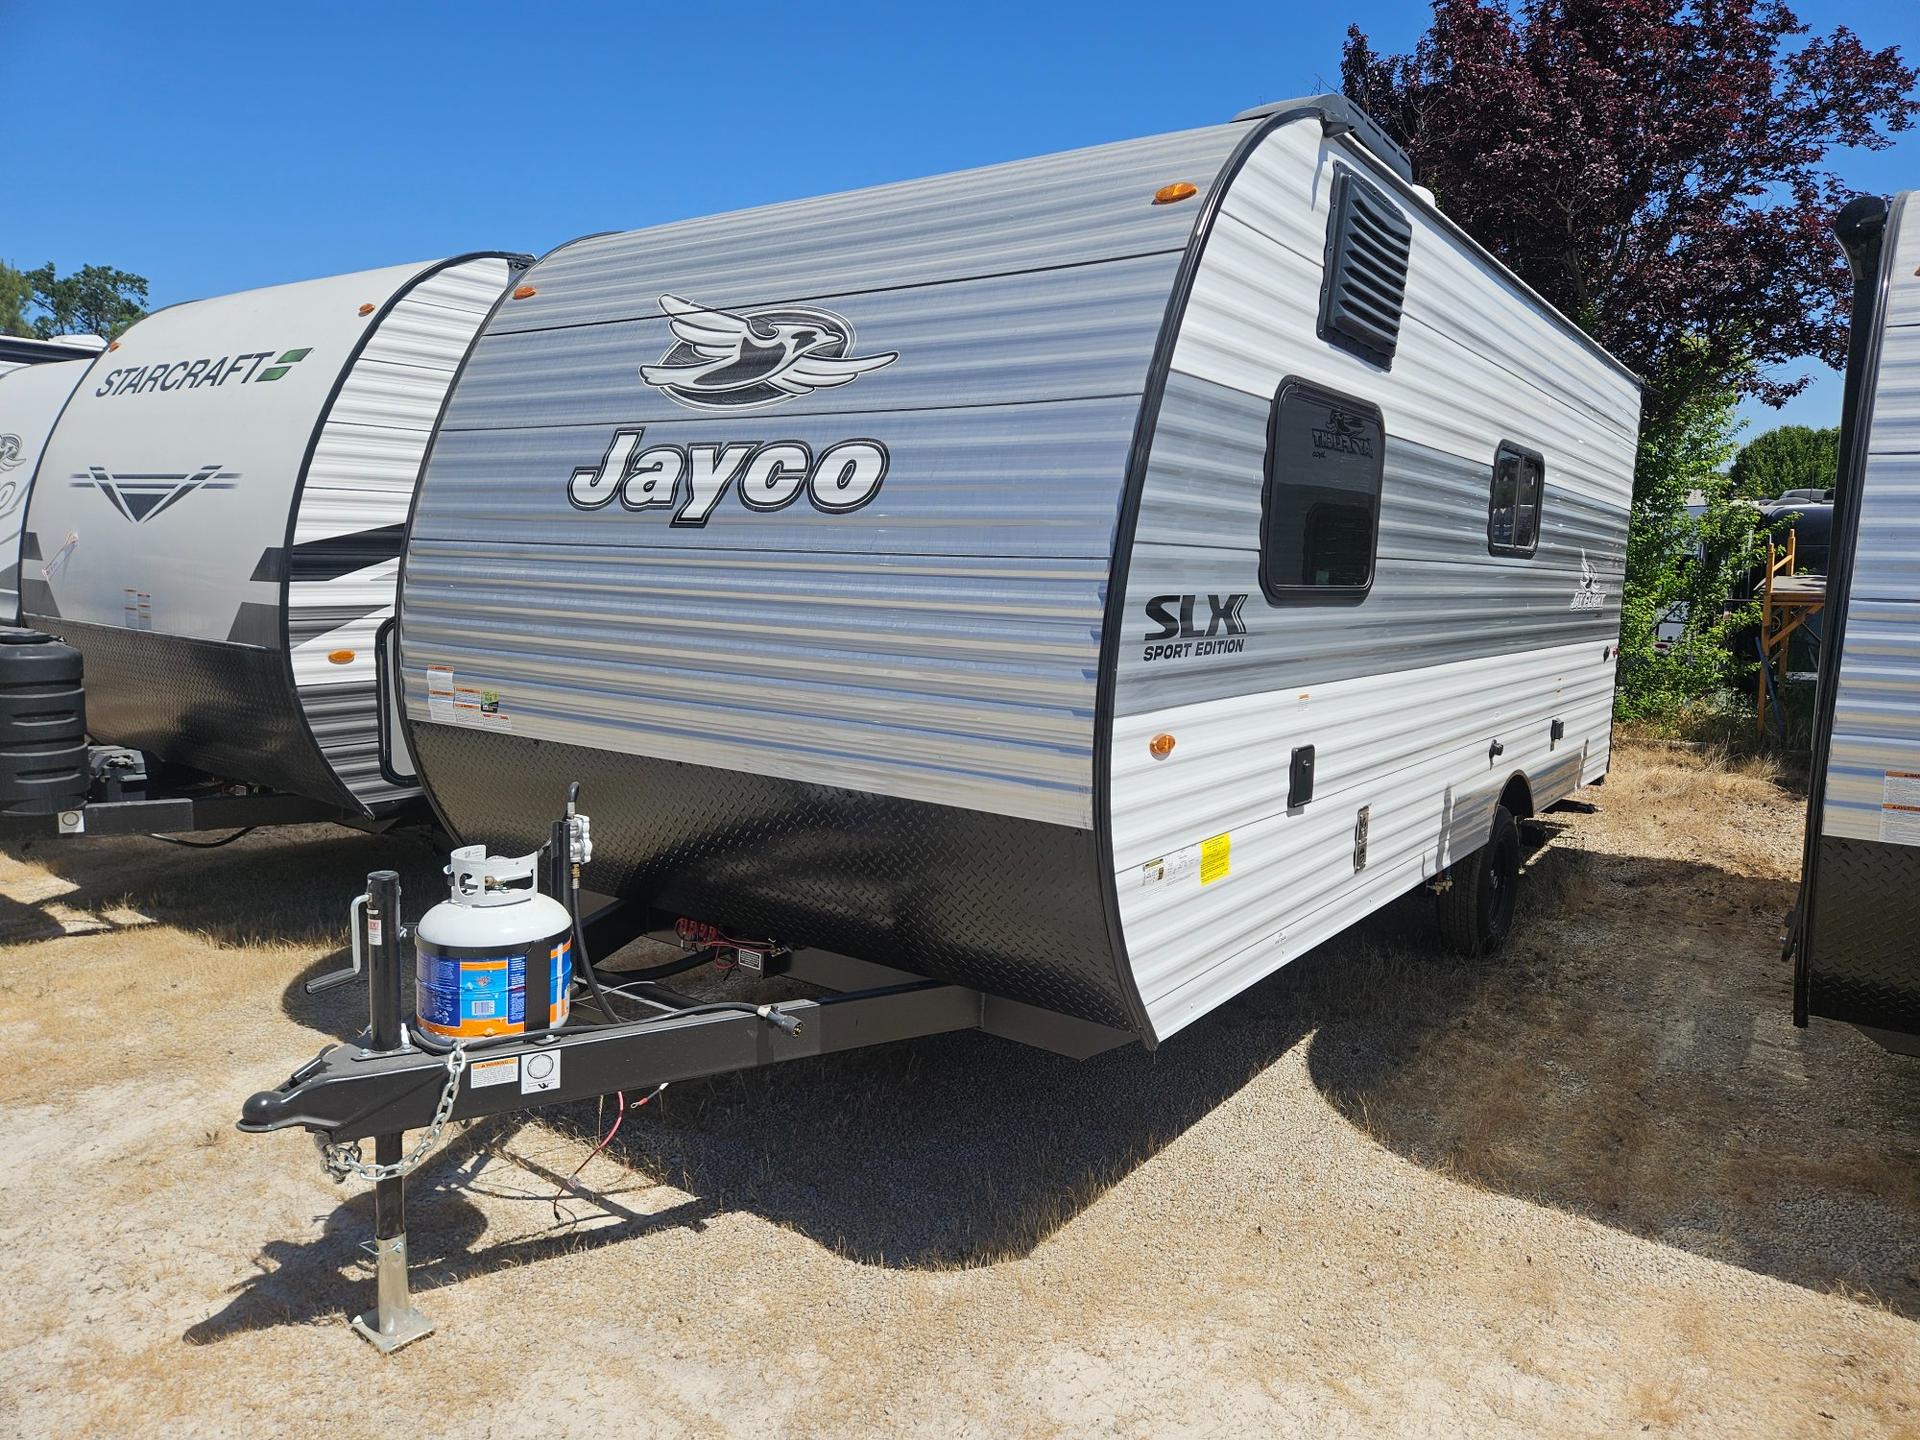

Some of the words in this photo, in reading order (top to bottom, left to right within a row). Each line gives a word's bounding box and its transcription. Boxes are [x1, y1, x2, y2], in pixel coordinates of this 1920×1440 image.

[95, 351, 276, 398] STARCRAFT
[567, 426, 890, 529] Jayco
[1144, 594, 1248, 640] SLX
[1143, 643, 1192, 661] SPORT
[1195, 639, 1244, 656] EDITION
